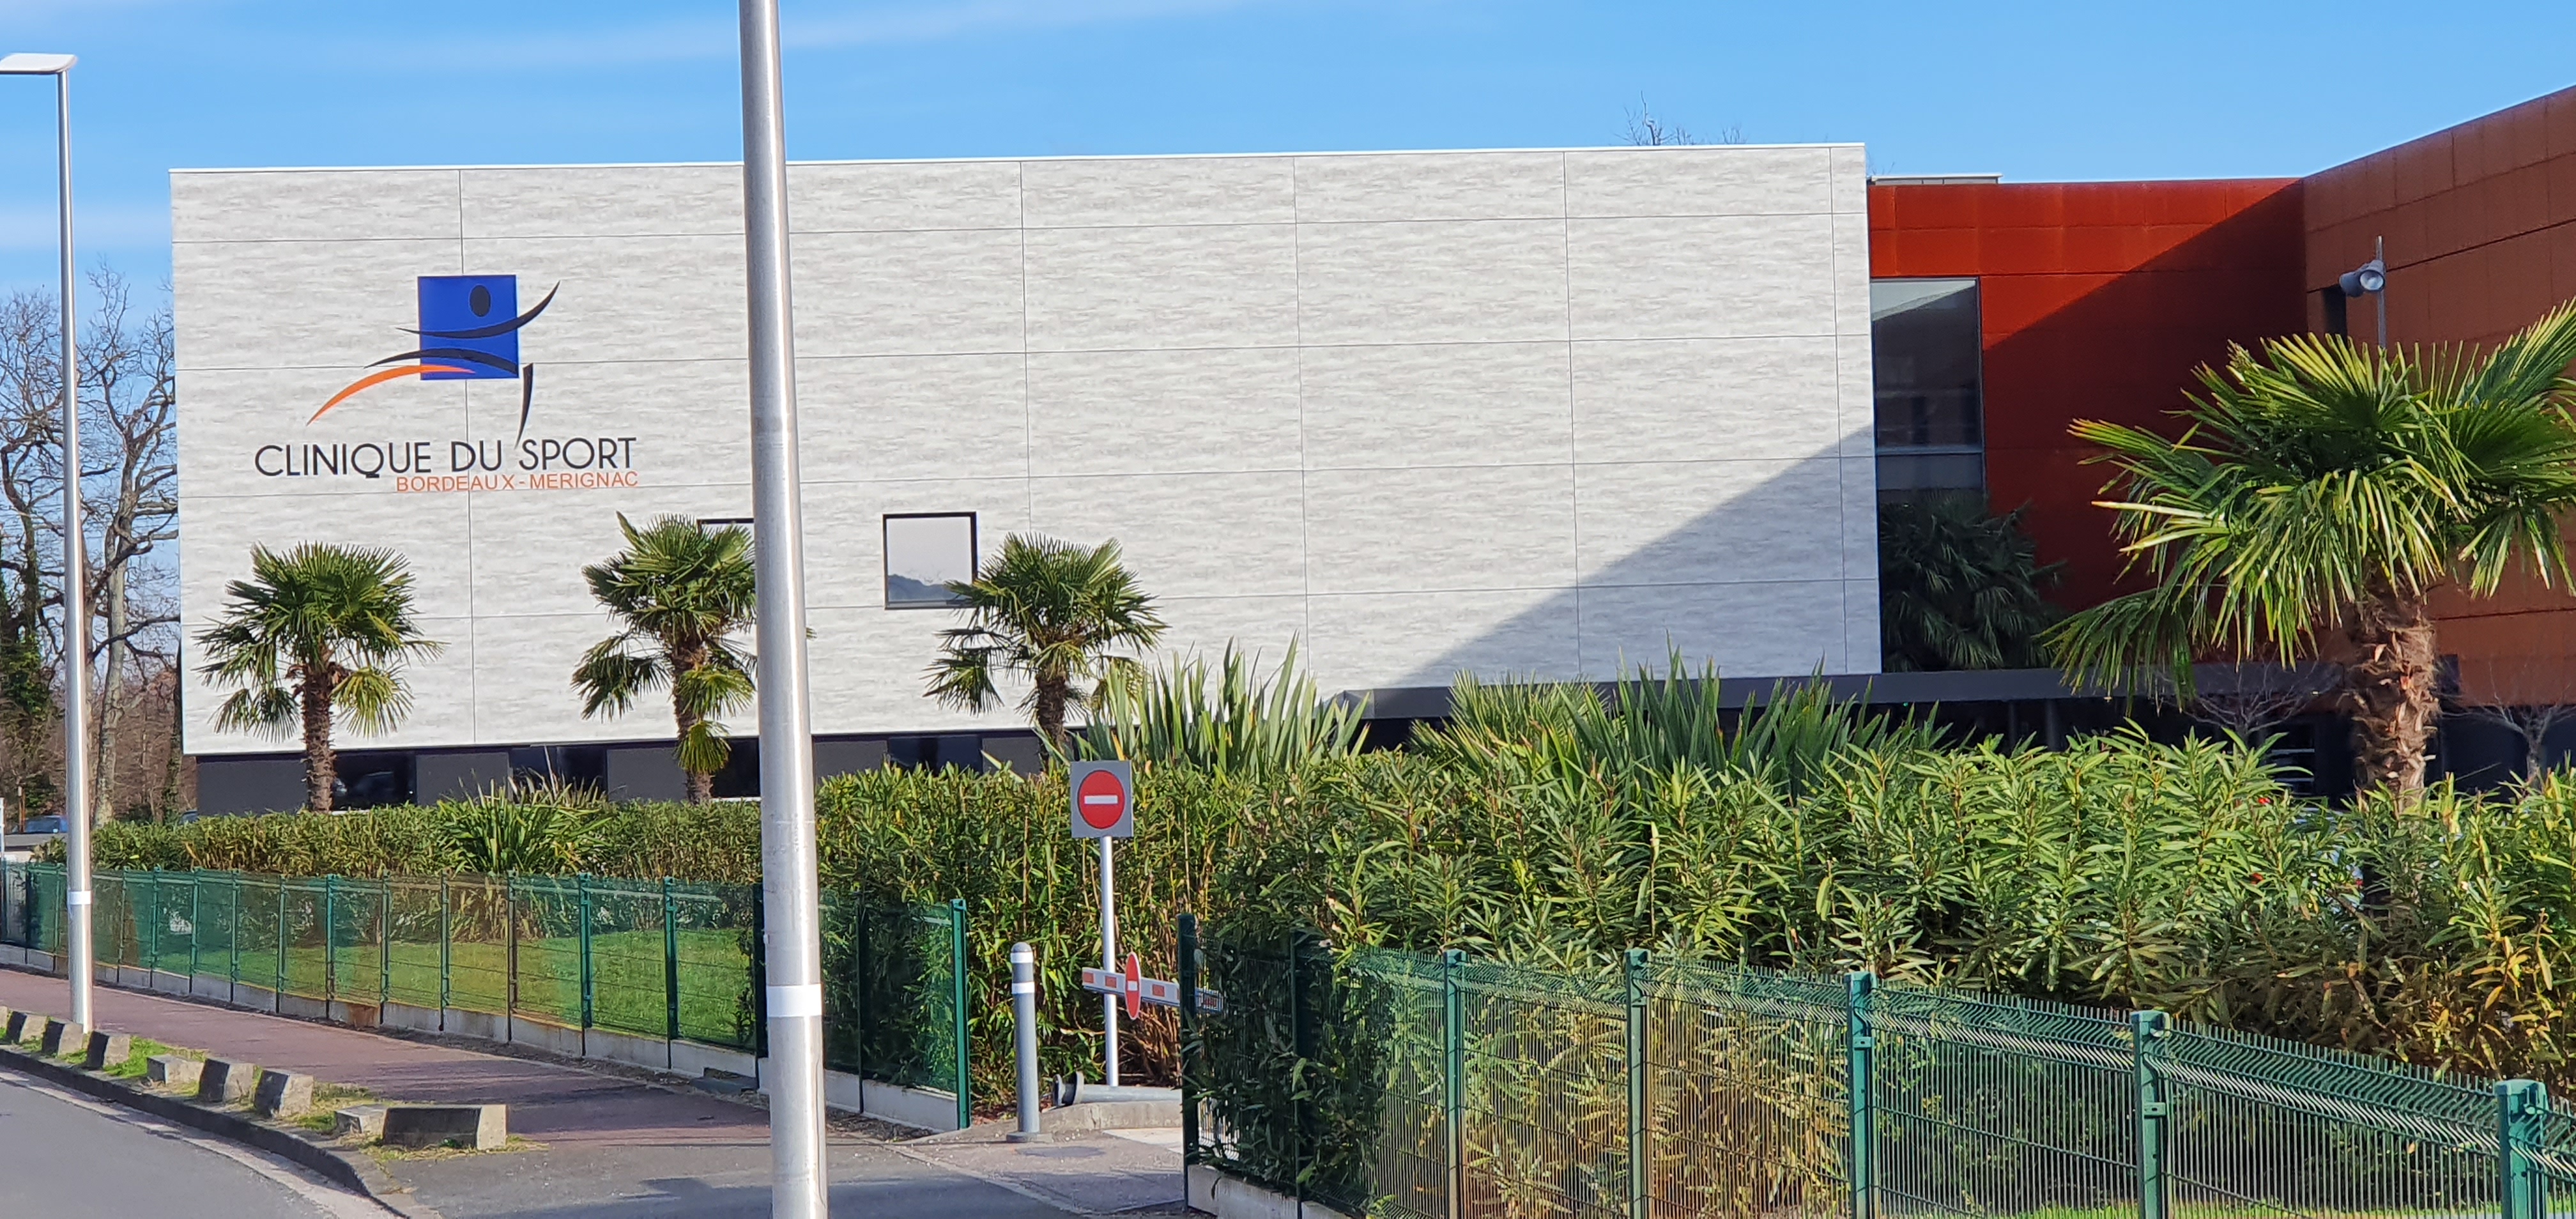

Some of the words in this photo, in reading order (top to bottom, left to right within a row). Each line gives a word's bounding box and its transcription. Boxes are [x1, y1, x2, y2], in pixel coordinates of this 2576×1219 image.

[256, 441, 432, 478] CLINIQUE
[451, 440, 502, 471] DU
[518, 437, 637, 471] SPORT
